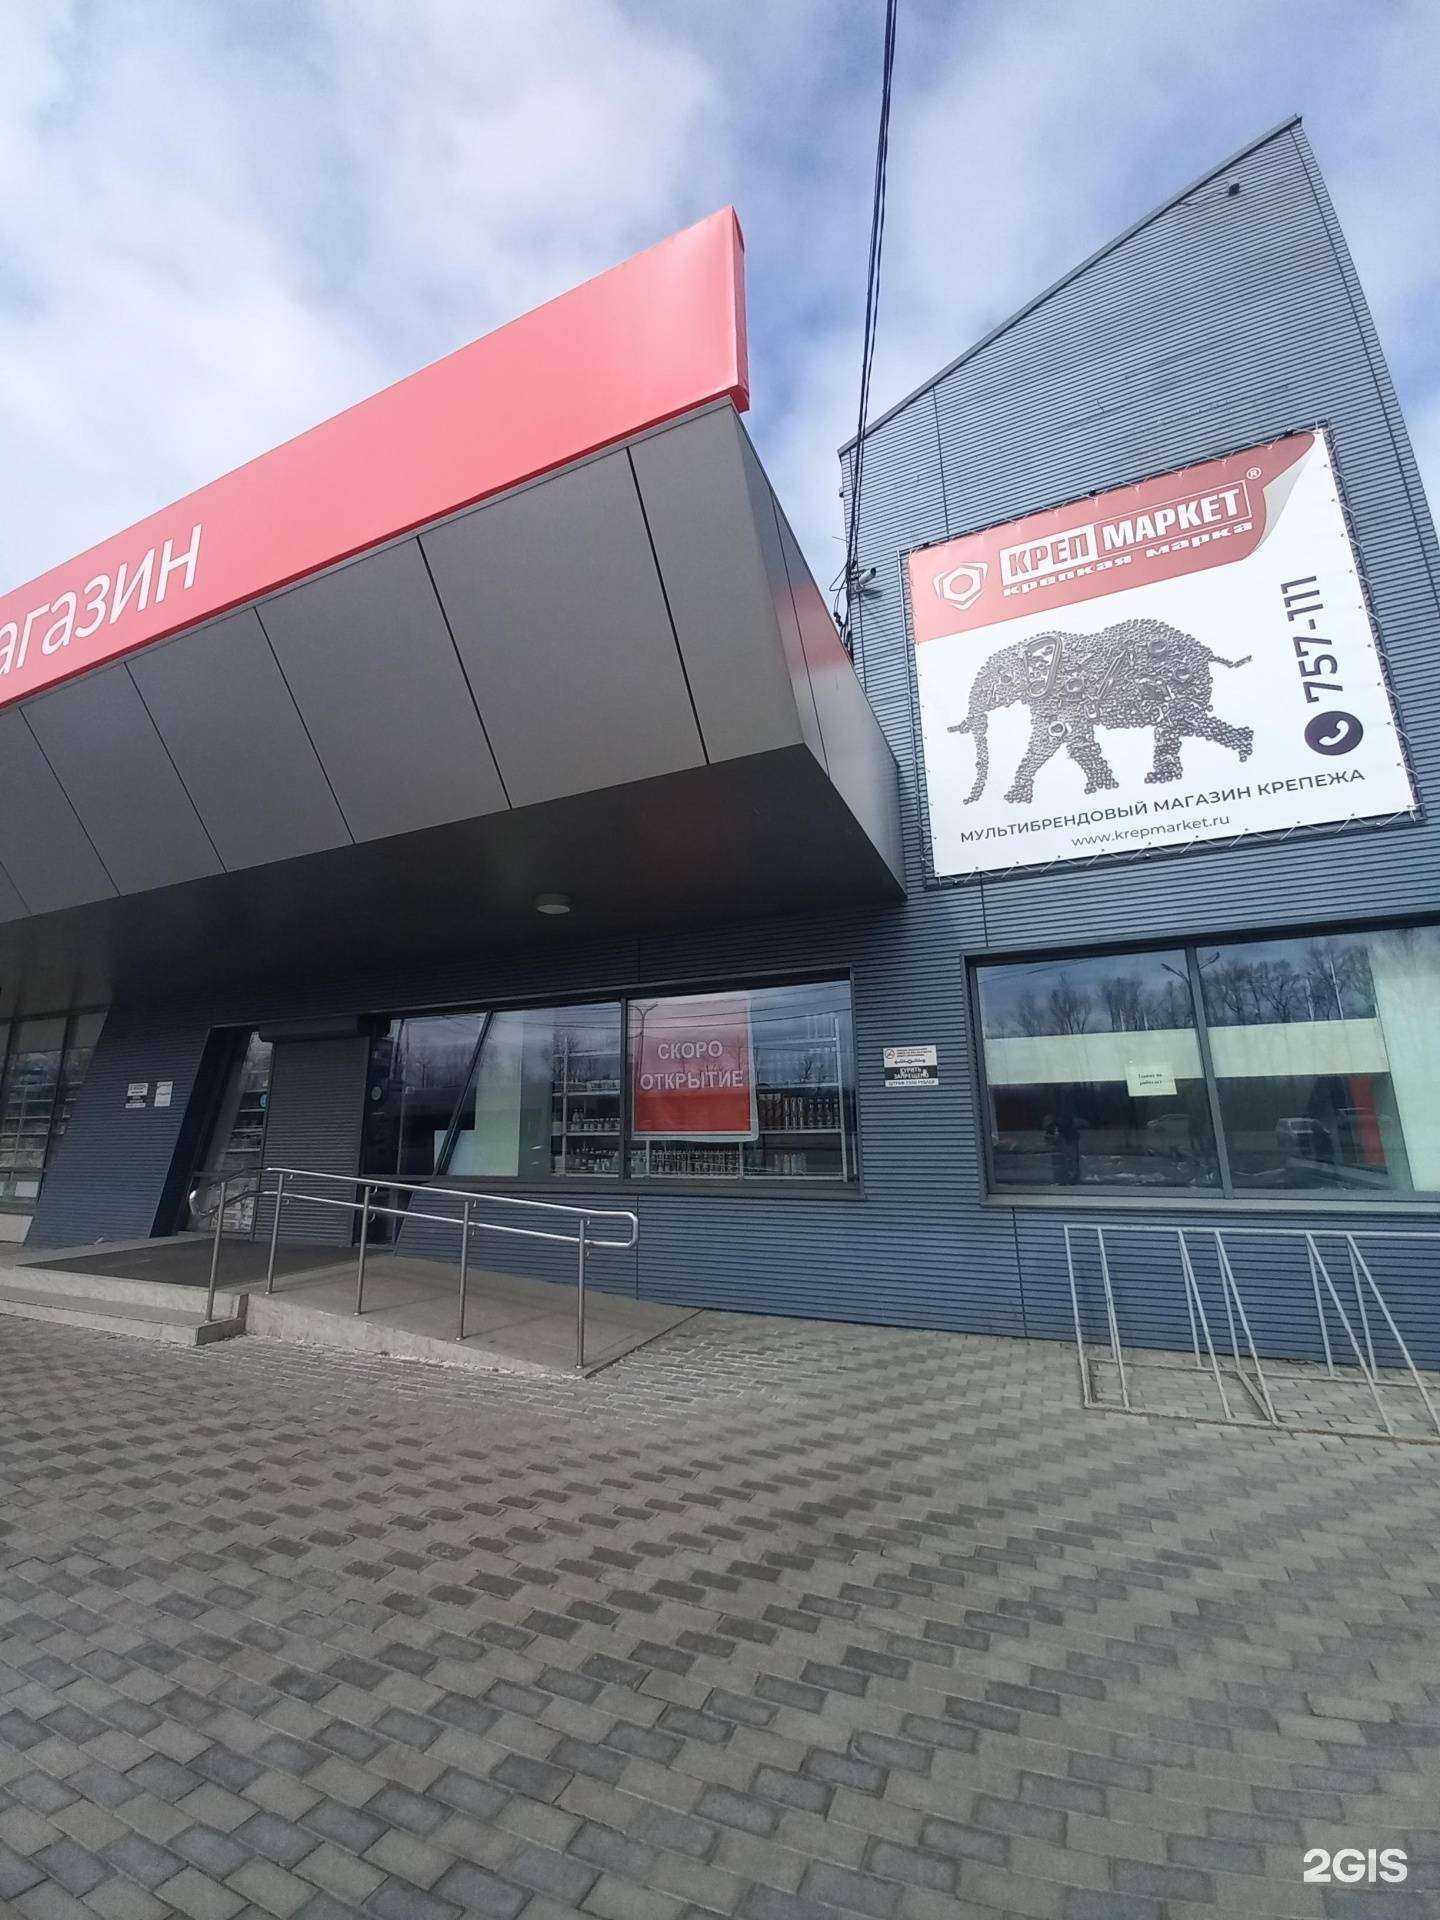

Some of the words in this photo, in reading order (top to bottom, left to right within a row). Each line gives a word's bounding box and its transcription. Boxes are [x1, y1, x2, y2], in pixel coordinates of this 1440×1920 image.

[1003, 555, 1133, 597] крепкая
[1146, 522, 1253, 558] марка
[1009, 532, 1090, 577] КРЕП
[1101, 488, 1240, 550] МАРКЕТ
[1280, 576, 1343, 703] 757-111
[960, 801, 1148, 843] МУЛЬТИБРЕНДОВЫЙ
[1153, 786, 1251, 813] МАГАЗИН
[1257, 769, 1366, 796] КРЕПЕЖА
[1071, 815, 1230, 847] www.krepmarket.ru
[640, 1070, 744, 1090] ОТКРЫТИЕ
[657, 1040, 723, 1060] СКОРО
